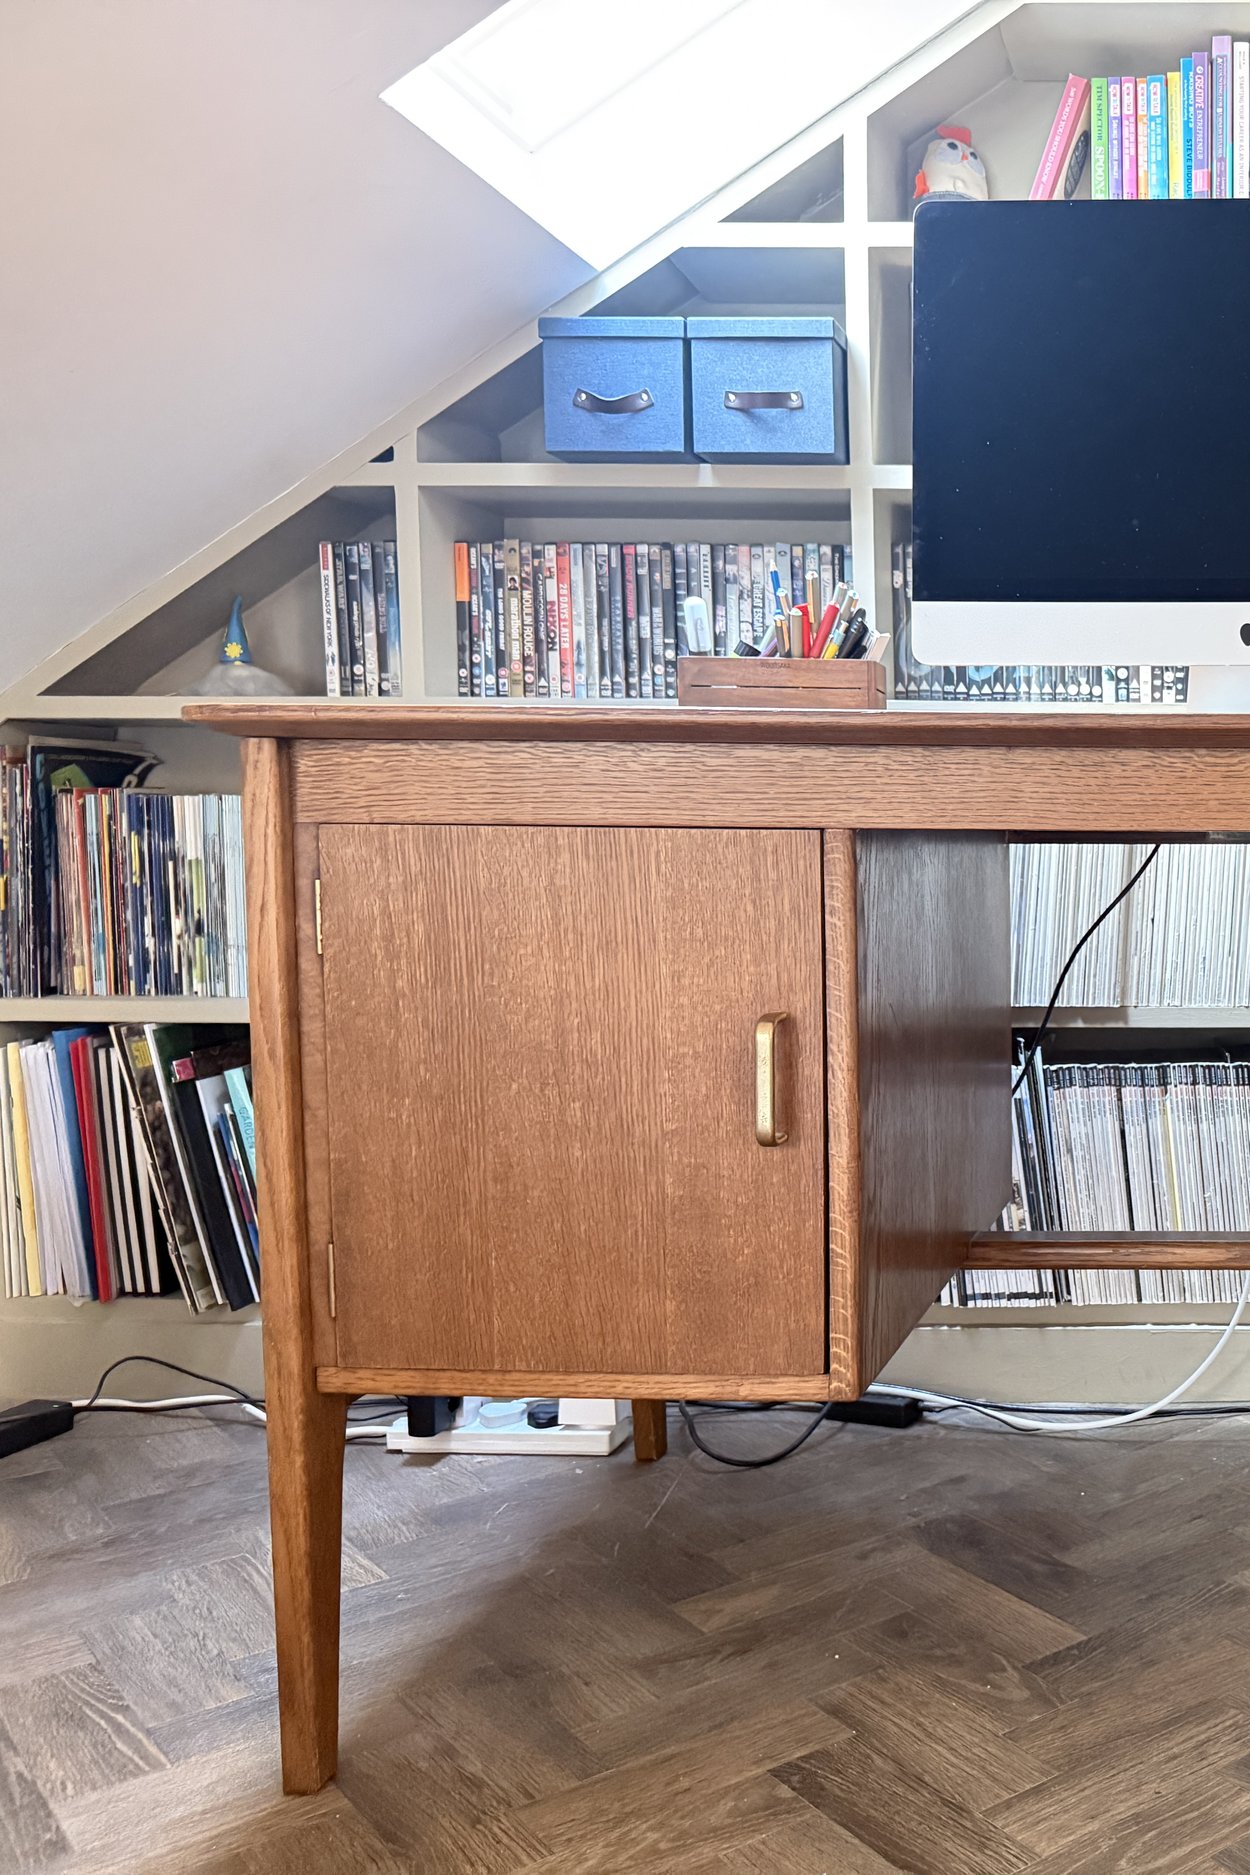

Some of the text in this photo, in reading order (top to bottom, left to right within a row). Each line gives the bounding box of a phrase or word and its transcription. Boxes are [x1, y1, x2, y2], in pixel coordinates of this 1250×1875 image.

[1195, 74, 1204, 109] CREATIVE
[1041, 98, 1072, 184] WORDS YOU SHOULD KNOW
[335, 558, 343, 584] STAR
[536, 573, 544, 621] CAPRICORN
[522, 590, 533, 657] MOULIN ROUGE
[547, 601, 557, 651] NIXON
[559, 584, 569, 649] 28 DAYS LATER
[627, 582, 635, 619] RUNNER
[753, 583, 763, 637] GREAT ESCAPE
[510, 598, 520, 660] marathon man
